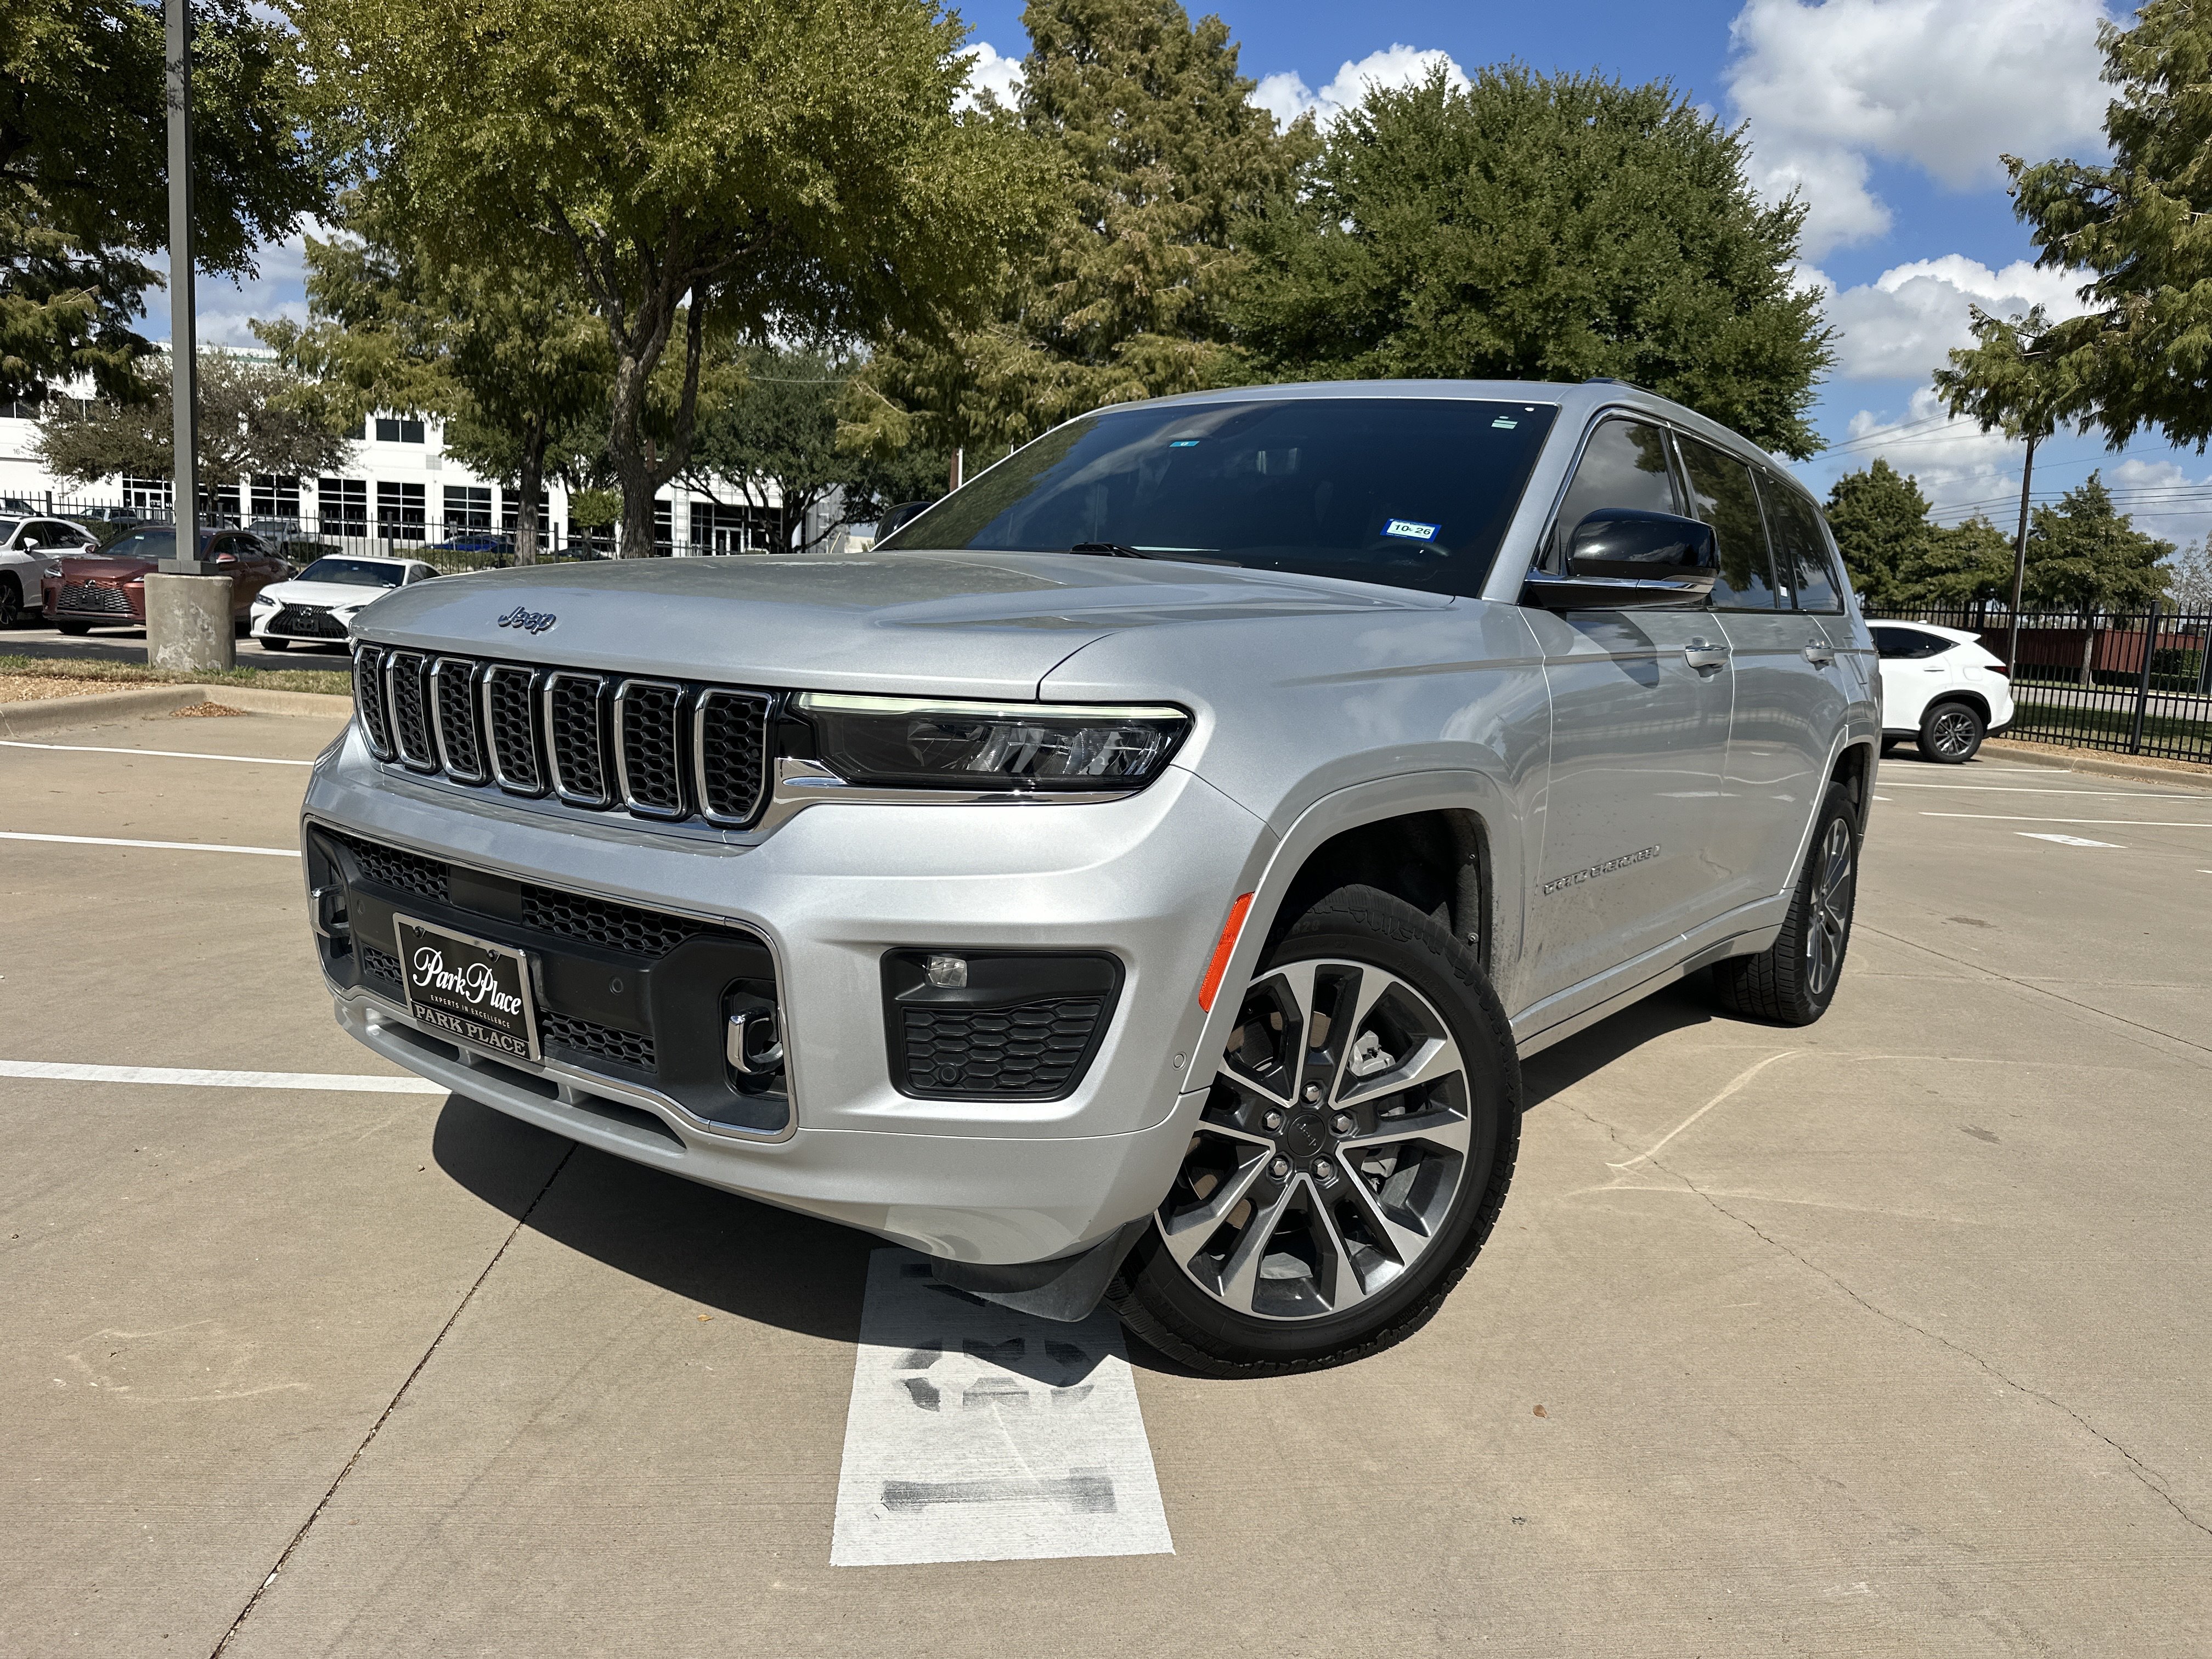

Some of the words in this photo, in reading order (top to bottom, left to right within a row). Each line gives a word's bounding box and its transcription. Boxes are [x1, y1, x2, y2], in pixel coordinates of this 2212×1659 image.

[498, 606, 556, 635] Jeep
[1590, 847, 1652, 878] CHEROKEE
[413, 946, 466, 995] Park
[465, 963, 522, 1015] Place
[430, 994, 460, 1009] EXPERTS
[462, 1004, 469, 1012] IN
[471, 1008, 511, 1029] EXCELLENCE
[414, 1004, 464, 1034] PARK
[466, 1022, 527, 1056] PLACE
